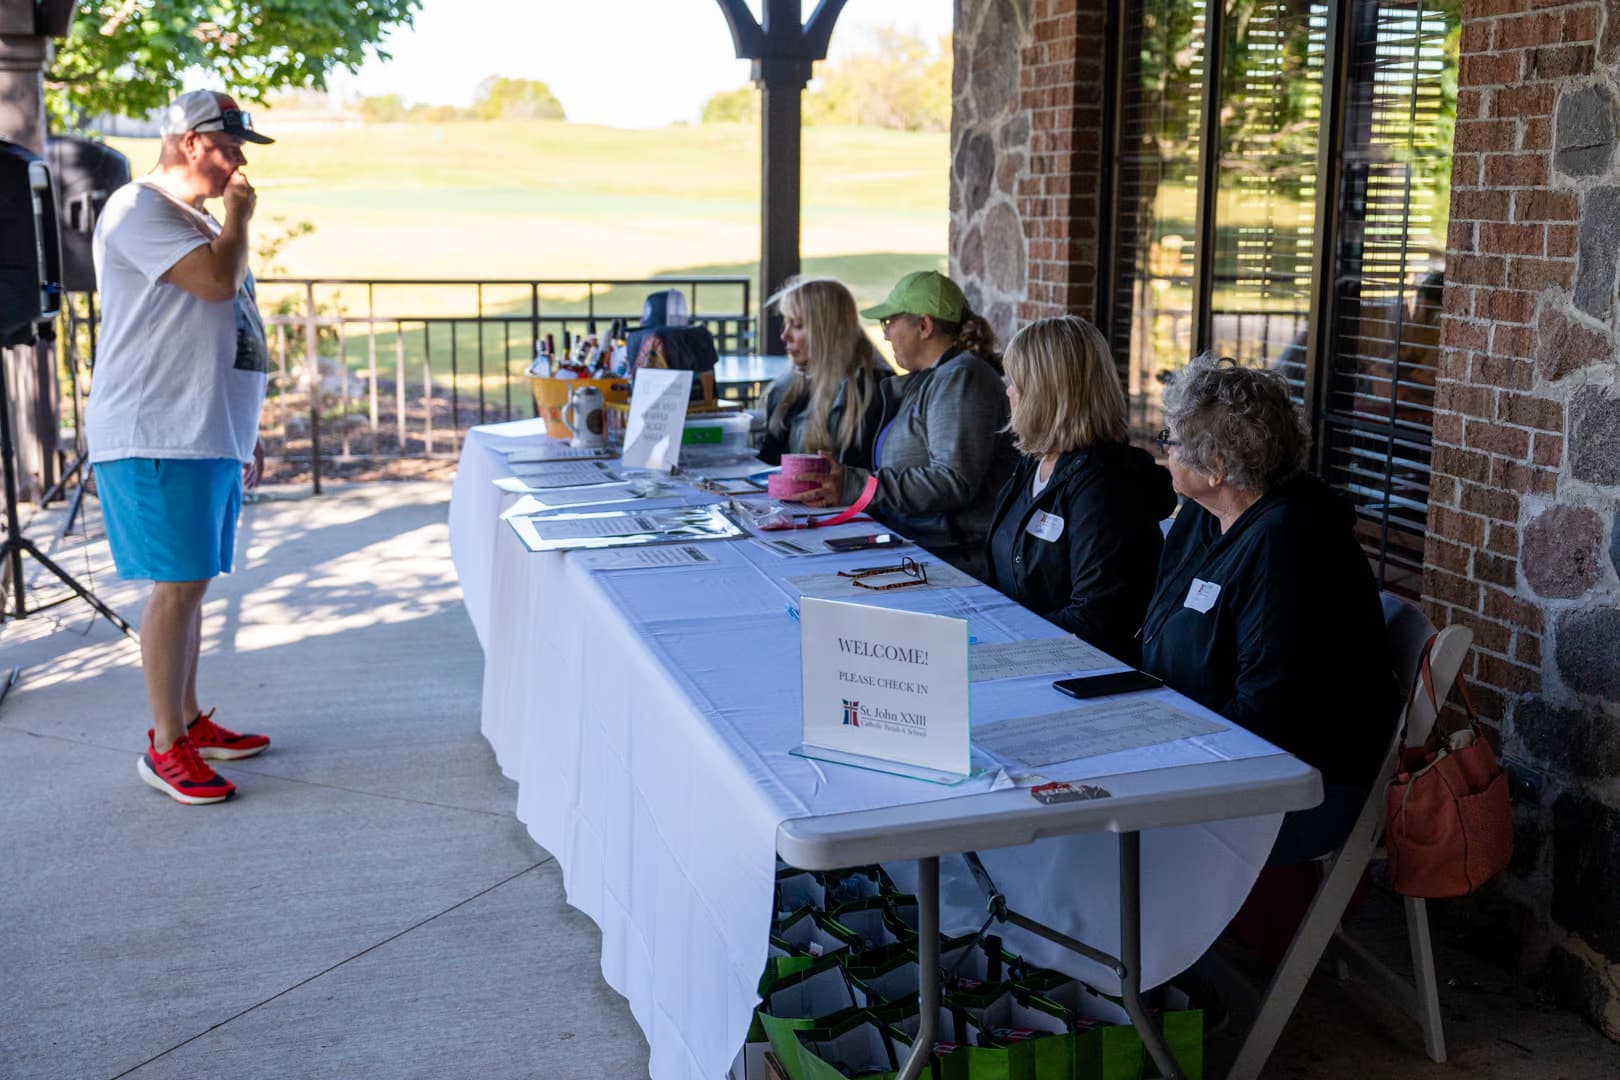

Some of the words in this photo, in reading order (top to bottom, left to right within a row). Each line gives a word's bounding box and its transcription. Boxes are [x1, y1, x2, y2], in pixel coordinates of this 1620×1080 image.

[838, 637, 929, 666] WELCOME!
[839, 671, 876, 687] PLEASE
[877, 677, 914, 694] CHECK
[916, 683, 929, 695] IN
[860, 704, 872, 717] St.
[875, 707, 898, 721] John
[900, 711, 927, 727] XXIII
